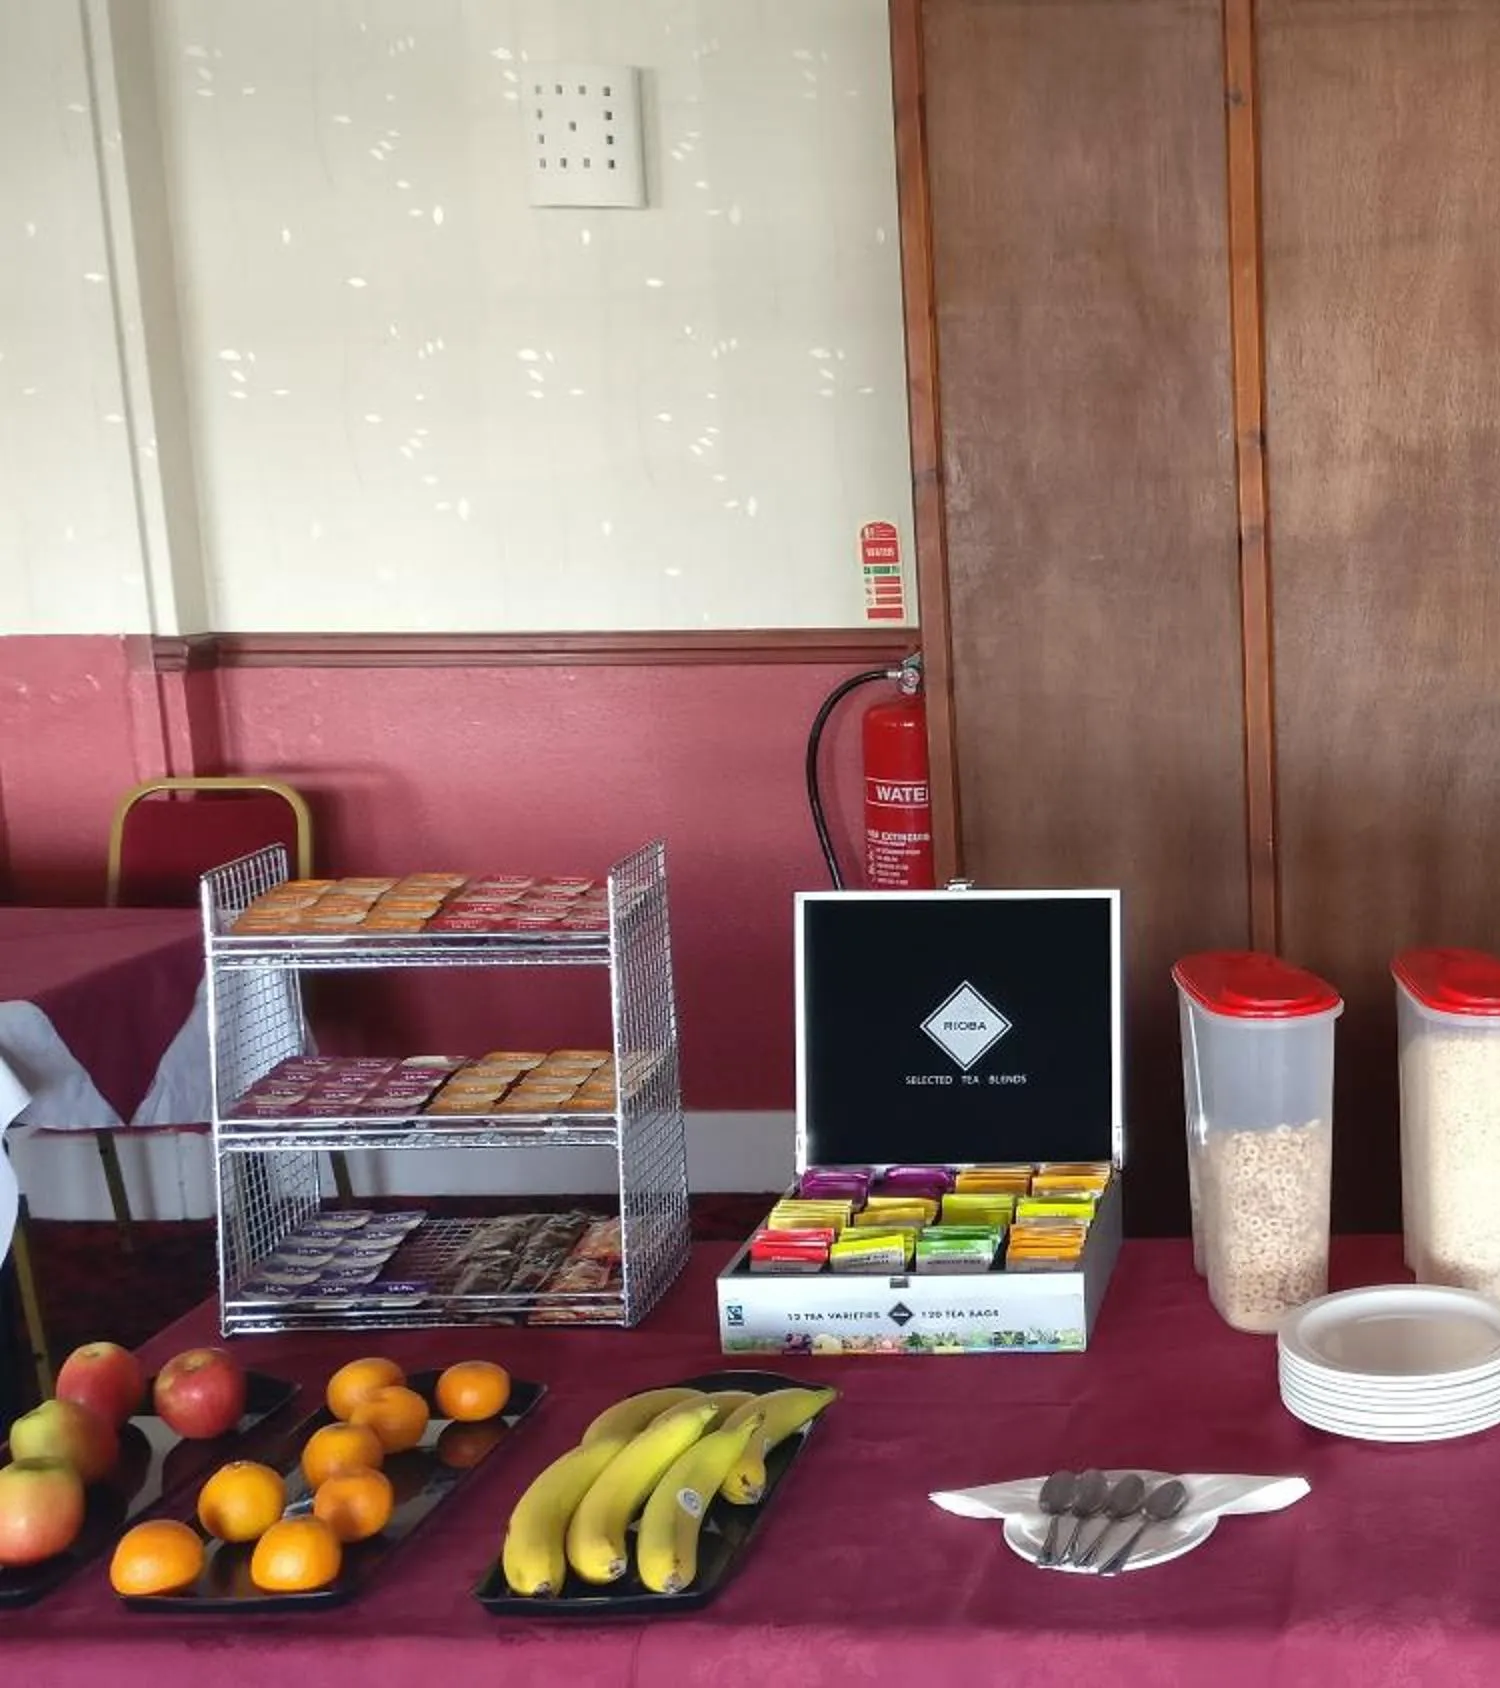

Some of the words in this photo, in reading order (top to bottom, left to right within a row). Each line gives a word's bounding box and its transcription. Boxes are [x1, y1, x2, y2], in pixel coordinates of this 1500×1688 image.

[876, 785, 929, 802] WATE
[943, 1021, 987, 1031] RIOBA
[905, 1075, 953, 1085] SELECTED
[961, 1075, 979, 1085] TEA
[988, 1074, 1027, 1085] BLENDS
[805, 1313, 825, 1321] TEA
